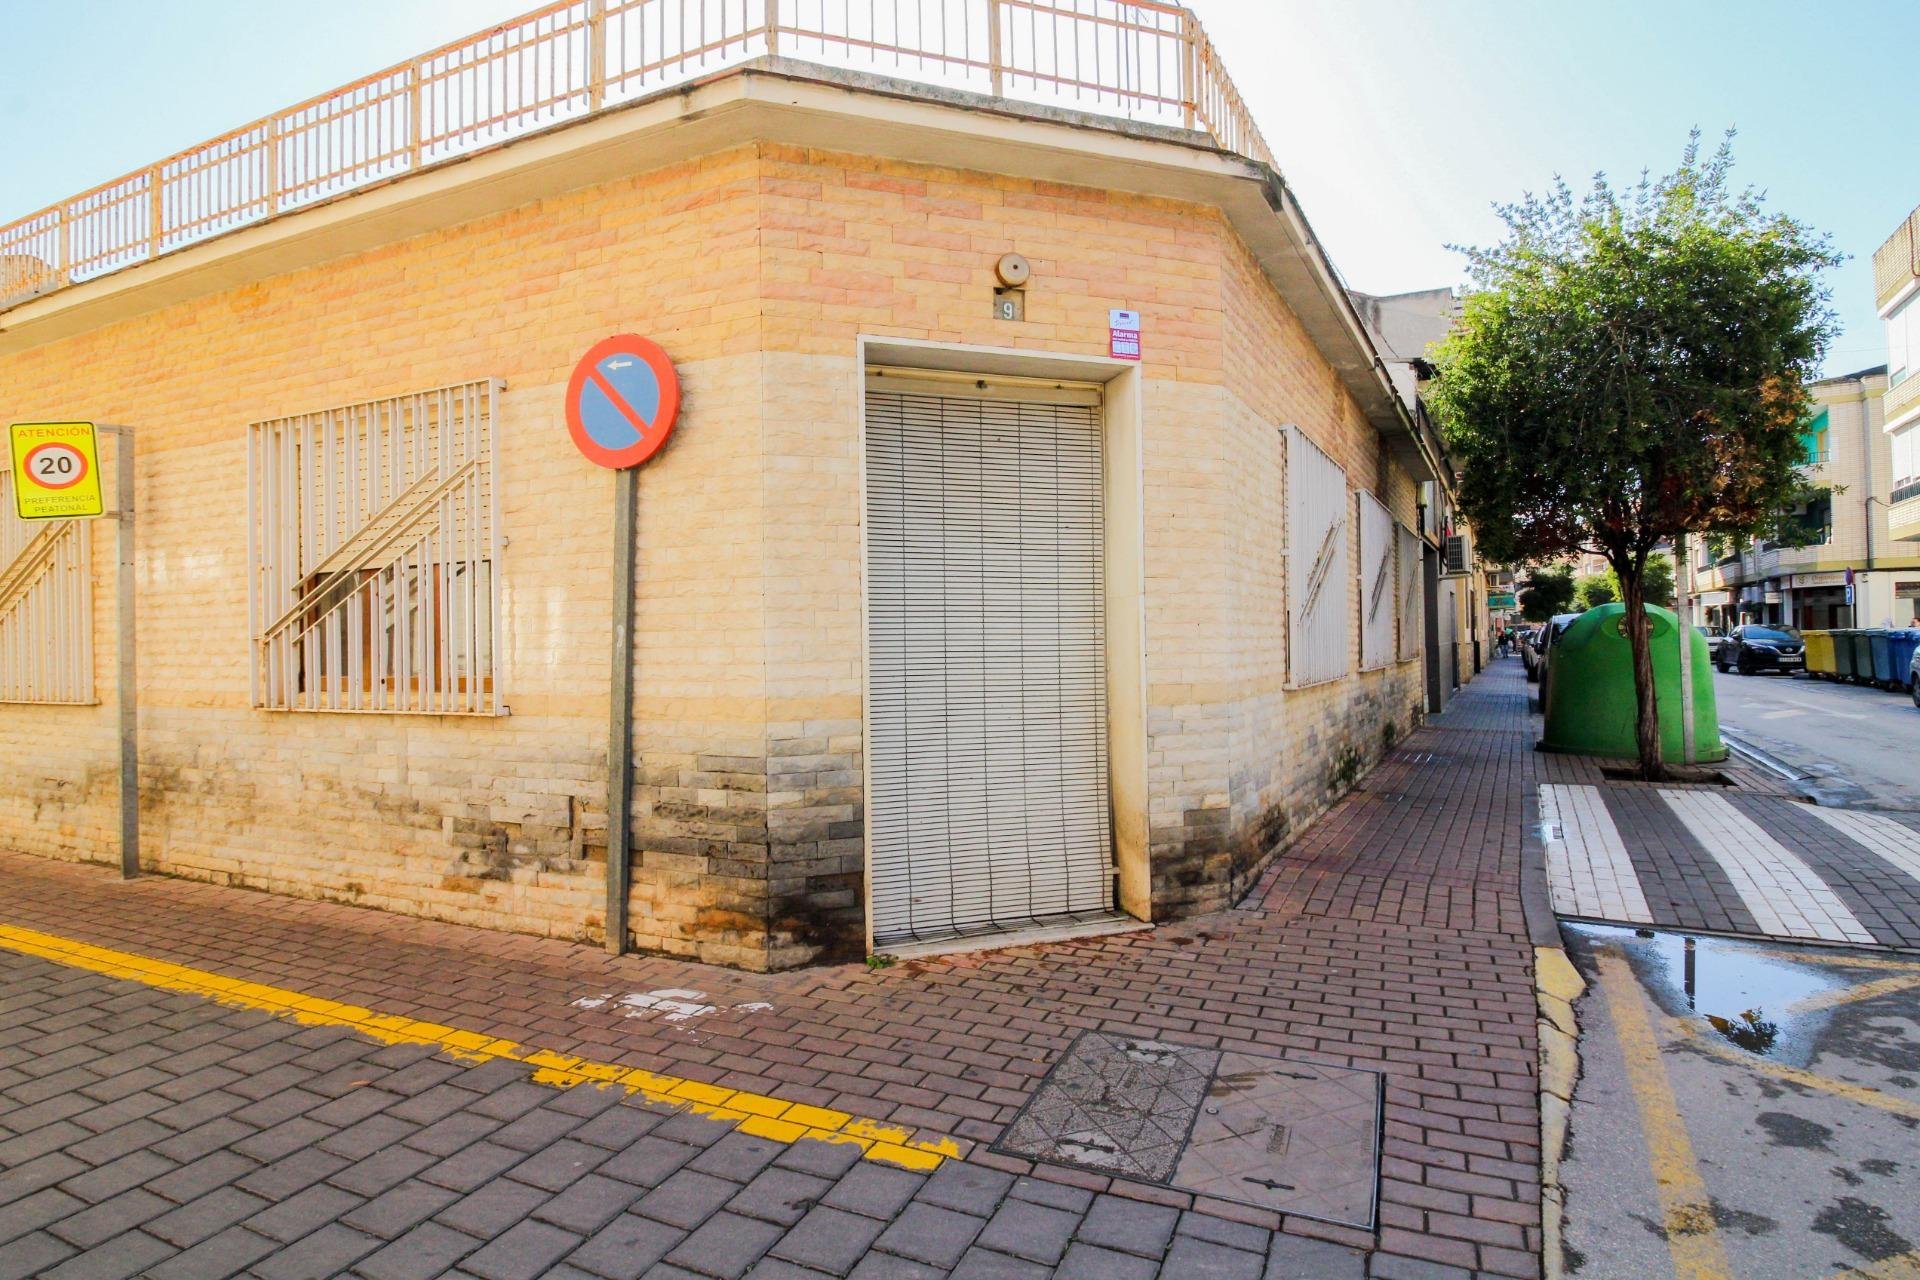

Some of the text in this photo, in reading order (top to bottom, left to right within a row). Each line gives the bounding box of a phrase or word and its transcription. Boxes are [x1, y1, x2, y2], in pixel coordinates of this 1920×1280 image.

[1003, 302, 1013, 319] 9
[1112, 329, 1138, 339] Alarma
[40, 456, 72, 475] 20
[24, 495, 96, 504] PREFERENCIA
[34, 504, 88, 513] PEATONAL
